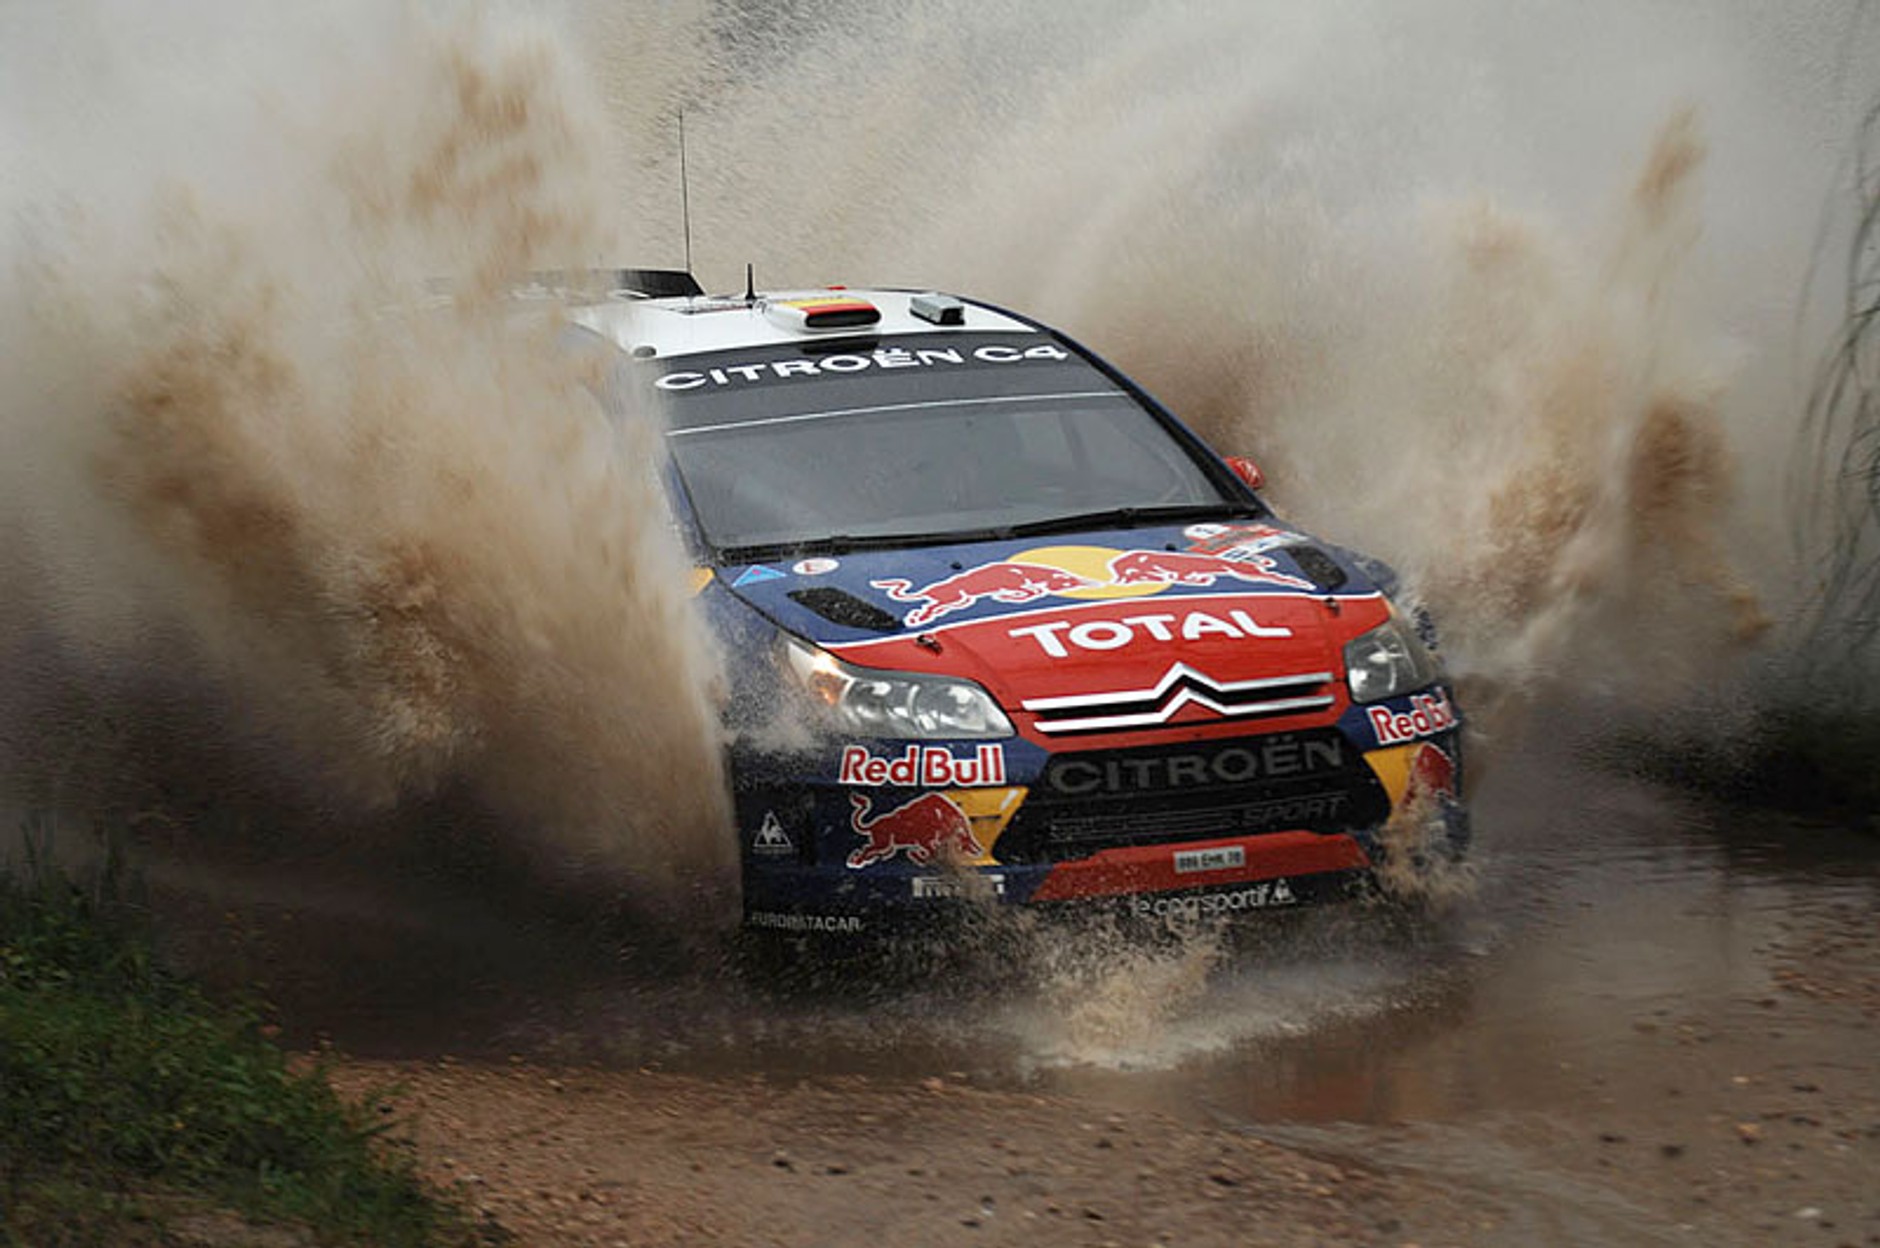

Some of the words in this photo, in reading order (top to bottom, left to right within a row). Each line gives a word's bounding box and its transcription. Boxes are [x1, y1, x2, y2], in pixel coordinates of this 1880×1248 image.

[655, 348, 963, 389] CITROËN
[973, 345, 1068, 362] C4
[1008, 610, 1292, 657] TOTAL
[838, 745, 919, 785] Red
[922, 743, 1006, 785] Bull
[1050, 735, 1342, 793] CITROËN
[1242, 798, 1347, 827] SPORT
[1201, 883, 1270, 913] sportif
